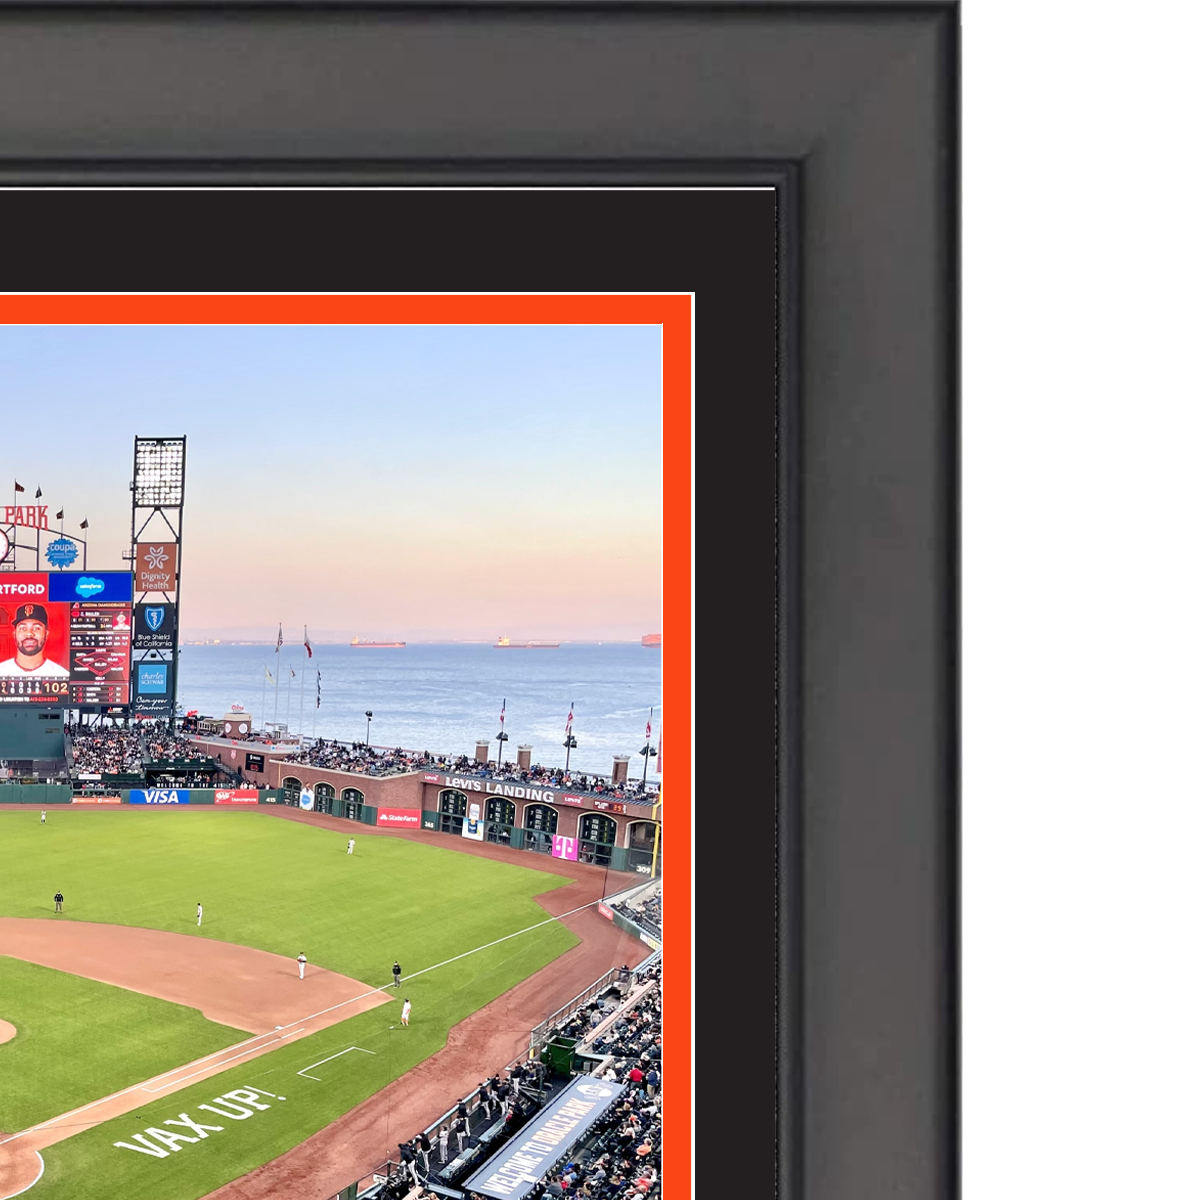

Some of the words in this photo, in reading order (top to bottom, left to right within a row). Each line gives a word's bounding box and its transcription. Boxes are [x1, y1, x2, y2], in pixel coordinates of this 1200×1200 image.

[4, 505, 48, 531] PARK
[50, 543, 76, 552] coupa
[141, 572, 170, 582] Dignity
[142, 582, 169, 590] Health
[141, 672, 164, 680] charles
[142, 790, 180, 804] VISA
[486, 782, 554, 803] LANDING
[636, 865, 651, 874] 309
[113, 1113, 224, 1158] VAX
[197, 1085, 286, 1120] UP!
[480, 1146, 544, 1195] WELCOME
[531, 1116, 579, 1147] ORACLE
[558, 1097, 597, 1123] PARK
